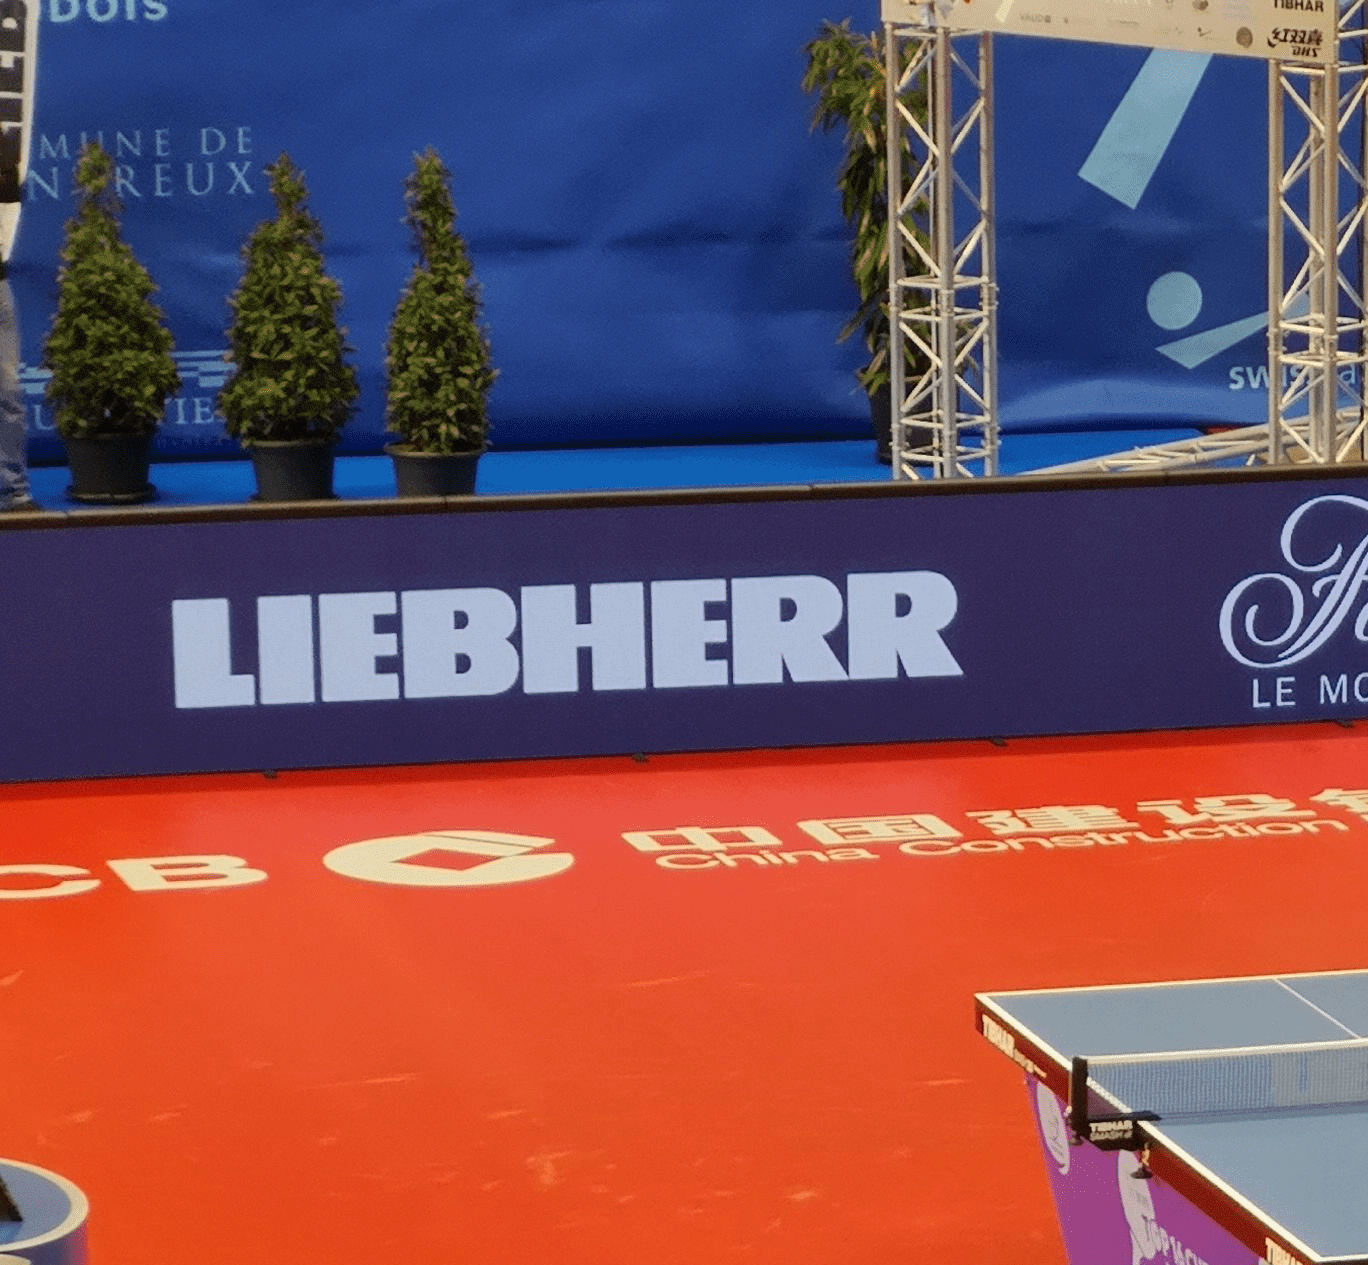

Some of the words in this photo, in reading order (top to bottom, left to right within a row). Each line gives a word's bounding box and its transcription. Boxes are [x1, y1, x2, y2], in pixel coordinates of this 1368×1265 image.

[201, 127, 253, 156] DE
[28, 162, 255, 200] NREUX
[172, 570, 964, 708] LIEBHERR
[1252, 677, 1296, 709] LE
[656, 846, 880, 869] China
[900, 818, 1348, 856] Construction
